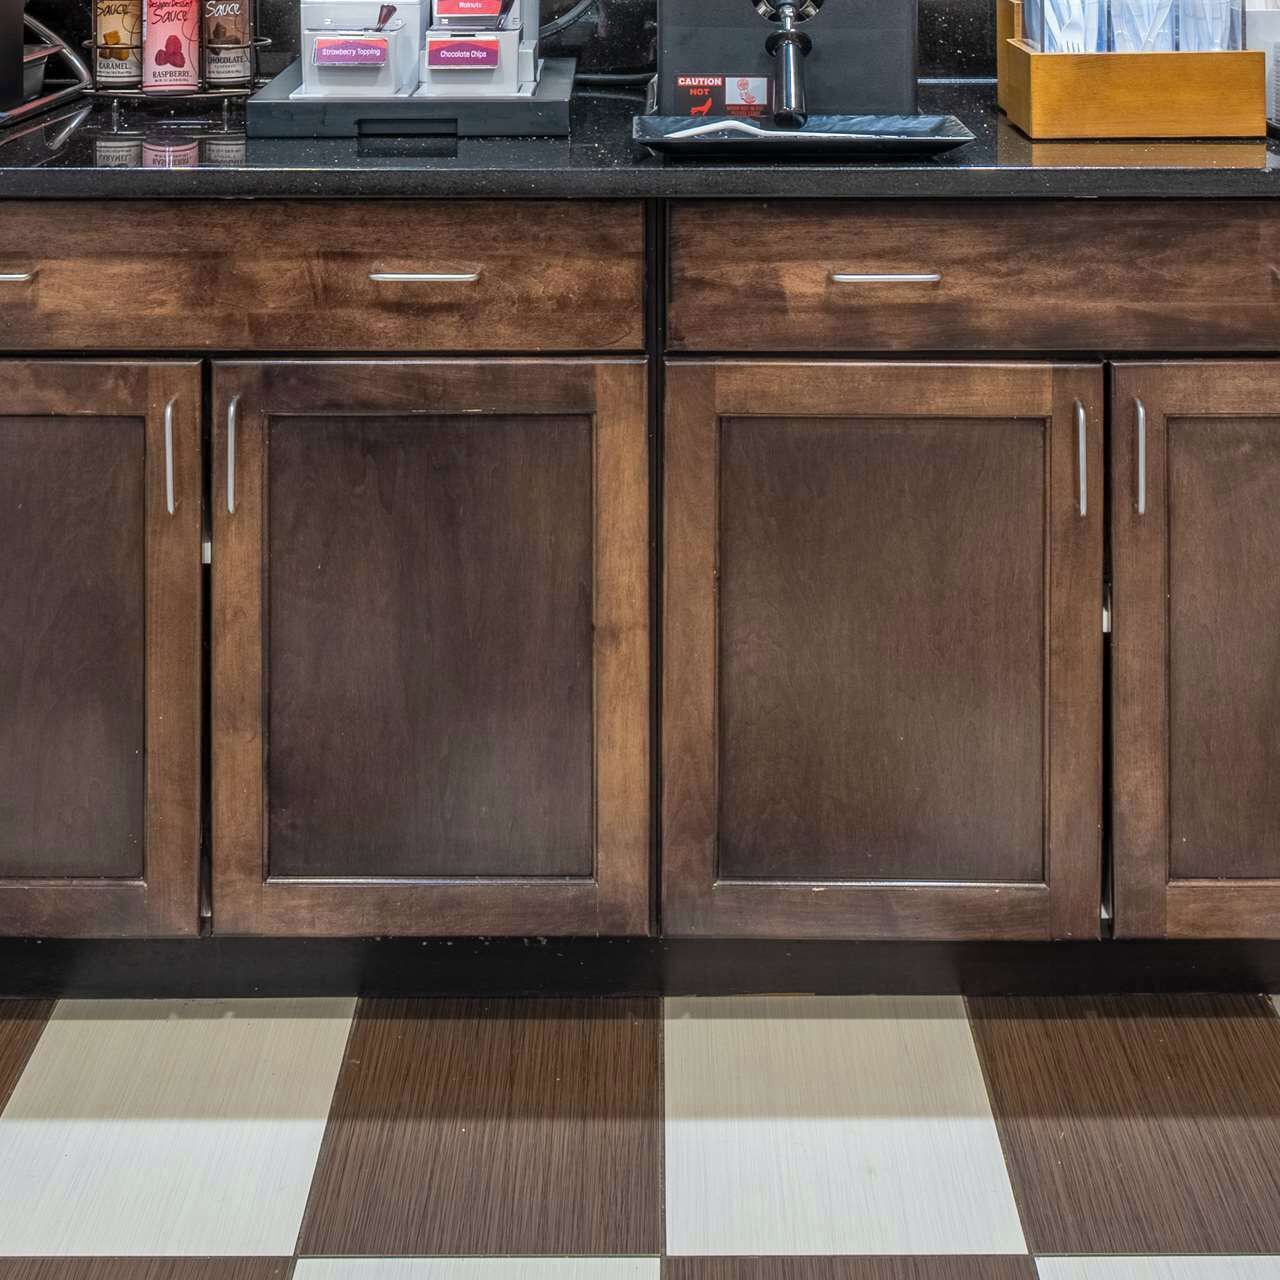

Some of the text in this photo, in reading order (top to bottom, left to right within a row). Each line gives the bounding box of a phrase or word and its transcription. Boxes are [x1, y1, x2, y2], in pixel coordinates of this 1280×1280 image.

[96, 0, 130, 17] Sauce
[205, 0, 241, 18] Sauce
[458, 1, 482, 9] Walnuts
[151, 9, 188, 24] Sauce
[322, 48, 381, 57] Strawberry Topping
[440, 49, 487, 59] Chocolate Chips
[152, 71, 190, 79] RASPBERRY
[678, 77, 722, 86] CAUTION
